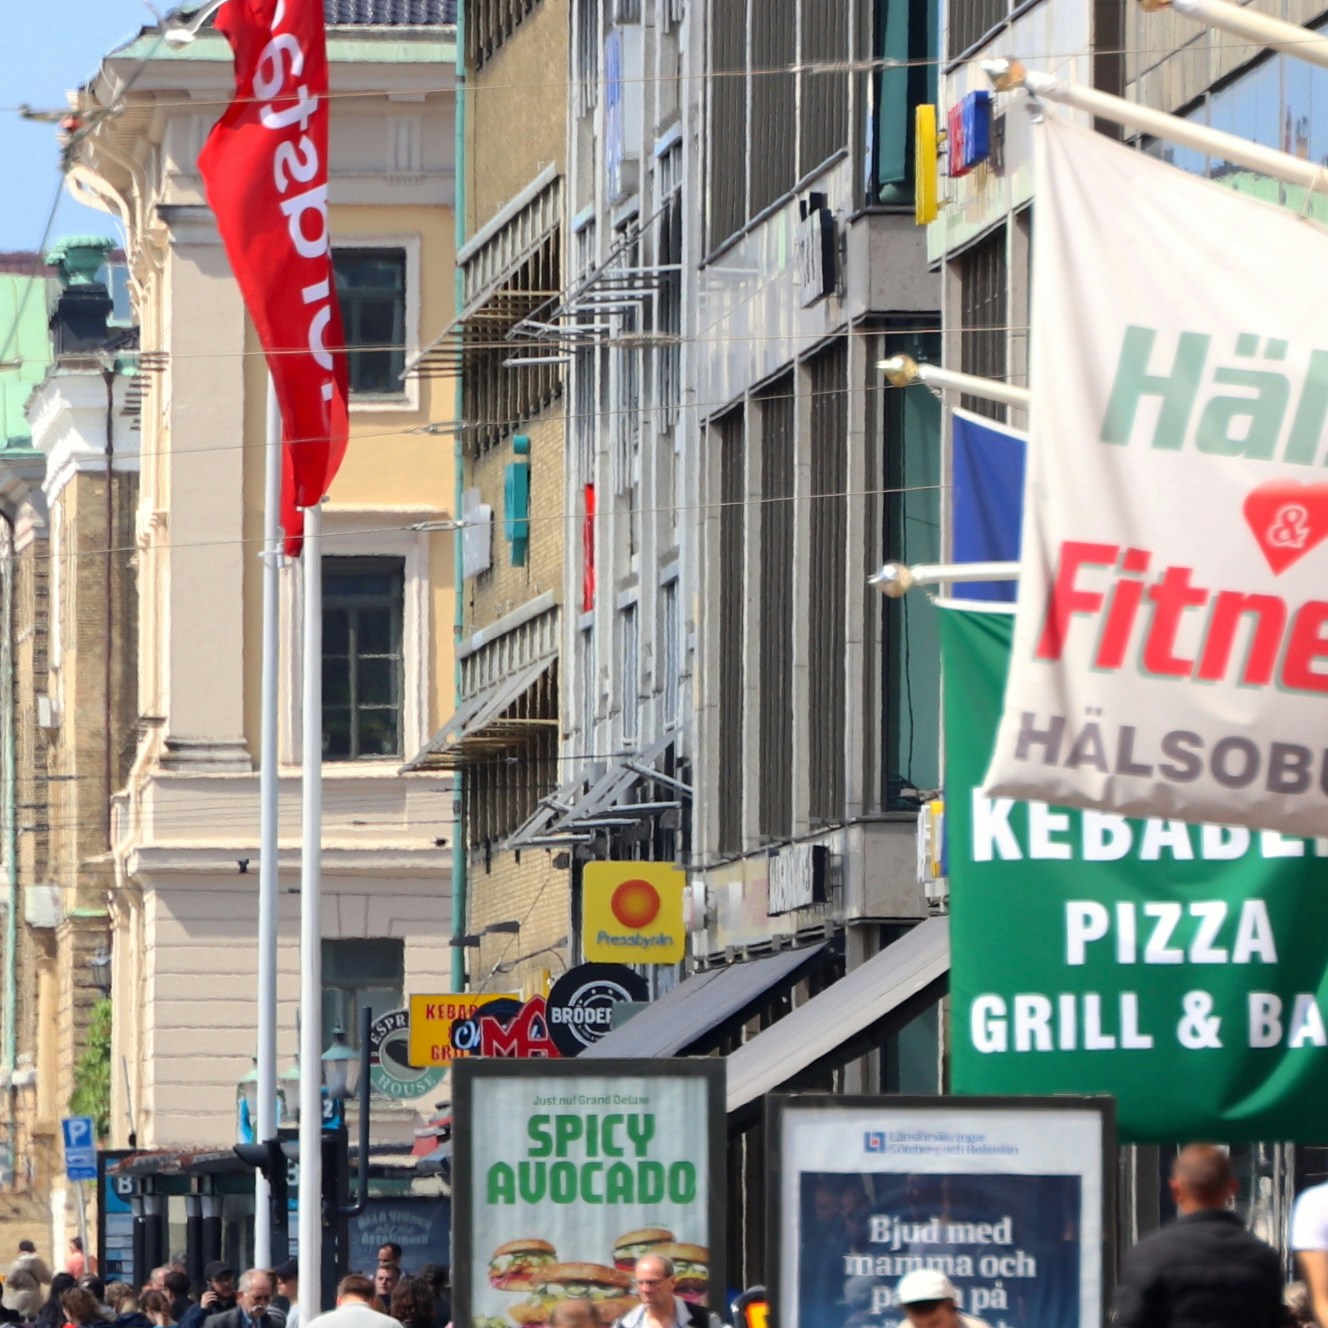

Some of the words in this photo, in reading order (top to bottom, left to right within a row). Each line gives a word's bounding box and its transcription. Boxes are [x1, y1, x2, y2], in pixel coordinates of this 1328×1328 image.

[1099, 325, 1328, 468] Häl
[1265, 505, 1309, 549] &
[1014, 706, 1328, 796] HÄLSOB
[1065, 899, 1278, 966] PIZZA
[970, 992, 1154, 1053] GRILL
[1177, 991, 1223, 1049] &
[1248, 992, 1327, 1049] BA
[378, 1074, 437, 1096] HOUSE
[532, 1096, 557, 1106] Just
[578, 1095, 612, 1105] Grand
[613, 1095, 650, 1105] Deluxe
[68, 1119, 88, 1147] P
[527, 1113, 656, 1157] SPICY
[486, 1161, 696, 1205] AVOCADO
[869, 1214, 940, 1250] Bjud
[945, 1215, 1013, 1245] med
[843, 1254, 974, 1277] mamma
[978, 1250, 1037, 1278] och
[971, 1280, 1009, 1316] på
